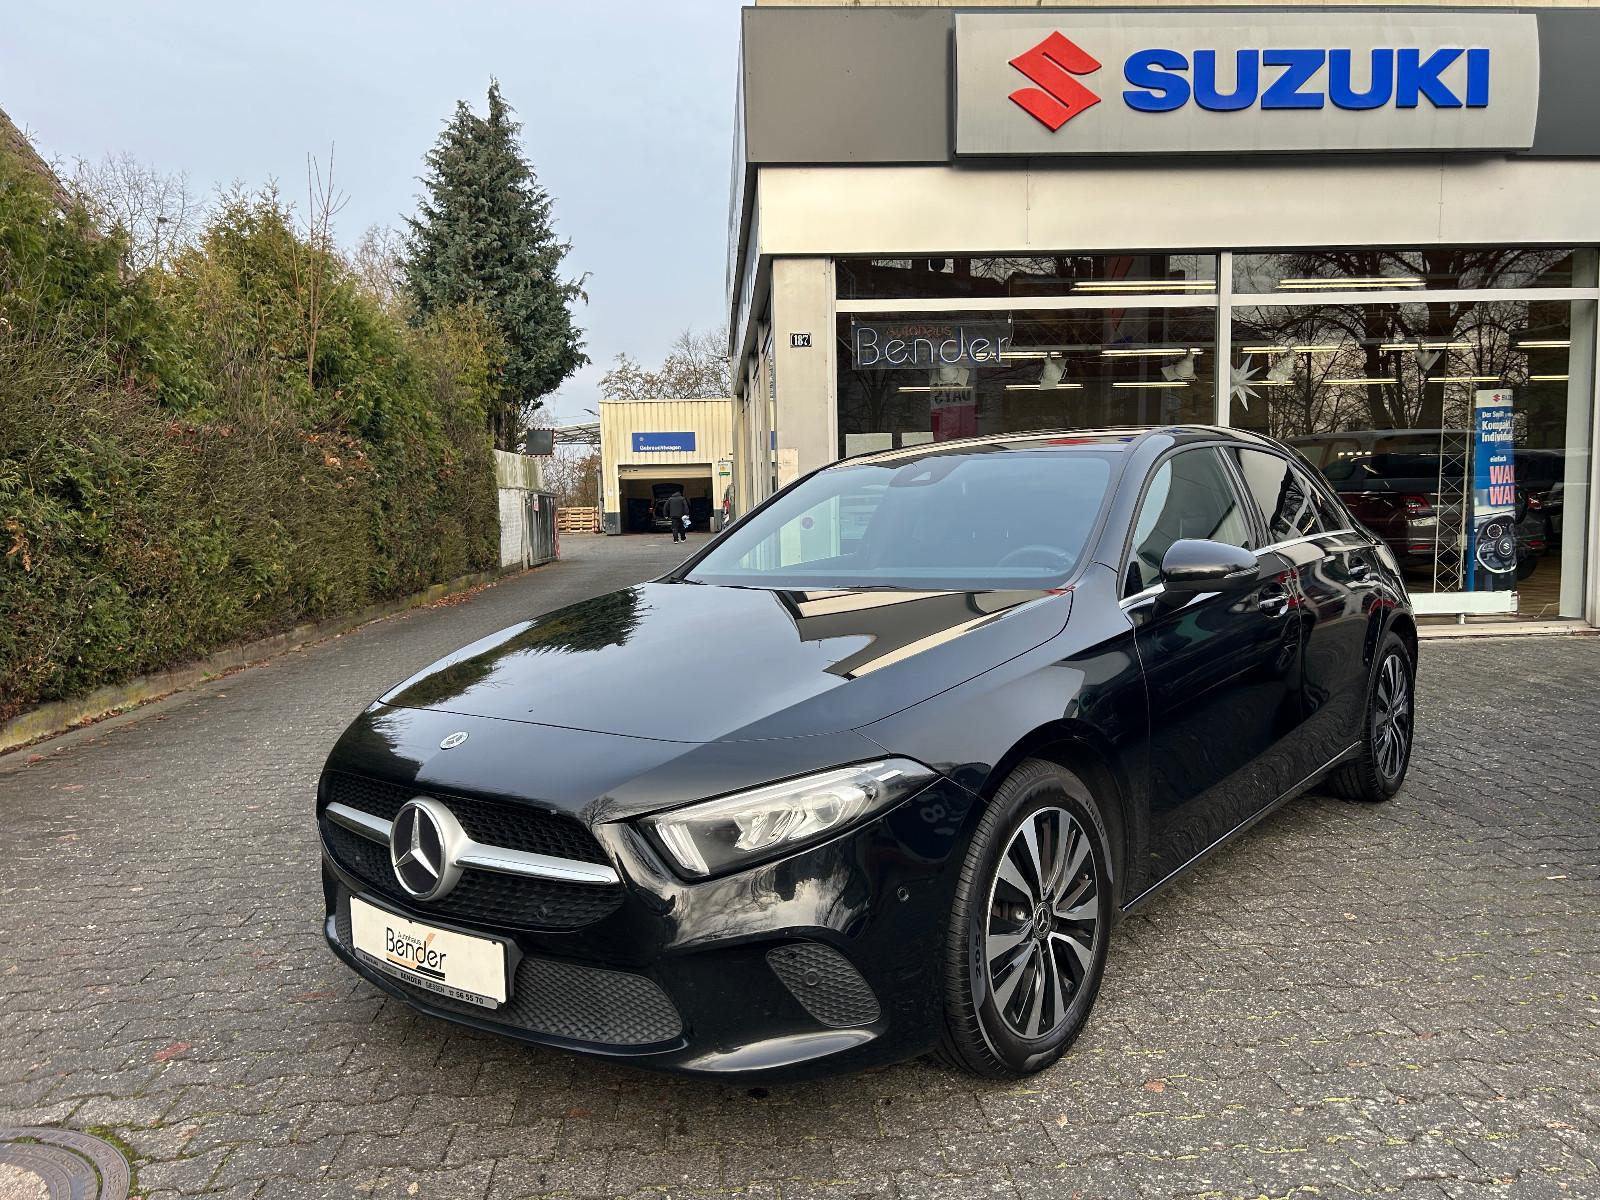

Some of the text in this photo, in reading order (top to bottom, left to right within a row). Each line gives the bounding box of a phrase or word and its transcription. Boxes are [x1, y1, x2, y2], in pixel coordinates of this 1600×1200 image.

[1122, 48, 1489, 111] SUZUKI
[793, 334, 809, 346] 187
[857, 327, 1009, 366] Bender
[386, 927, 447, 970] Bender
[400, 972, 422, 986] BENDER
[465, 994, 474, 1003] 55
